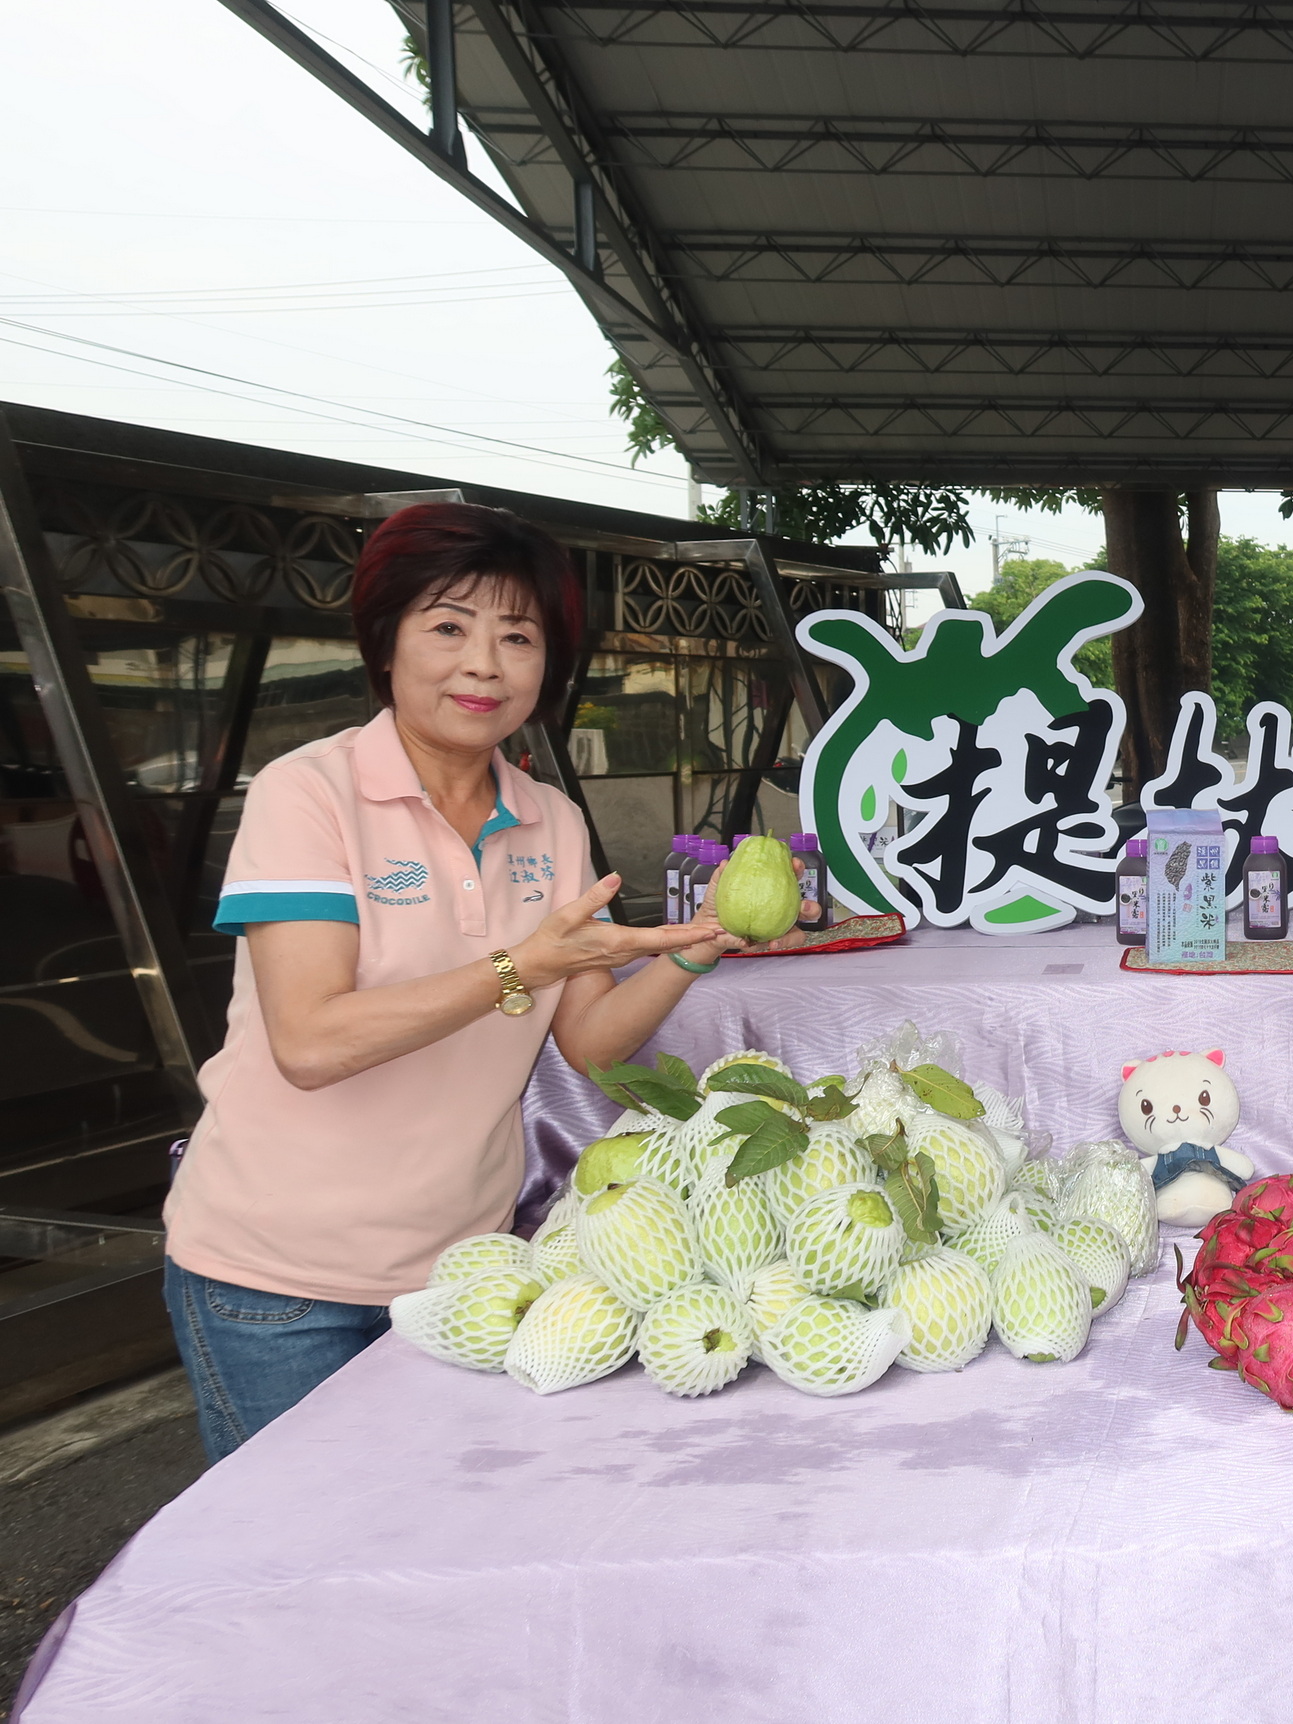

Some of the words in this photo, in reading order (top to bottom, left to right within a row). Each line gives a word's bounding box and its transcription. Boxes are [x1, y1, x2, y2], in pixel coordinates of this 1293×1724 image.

[366, 891, 431, 906] CROCODILE
[1200, 872, 1217, 930] 紫黑米
